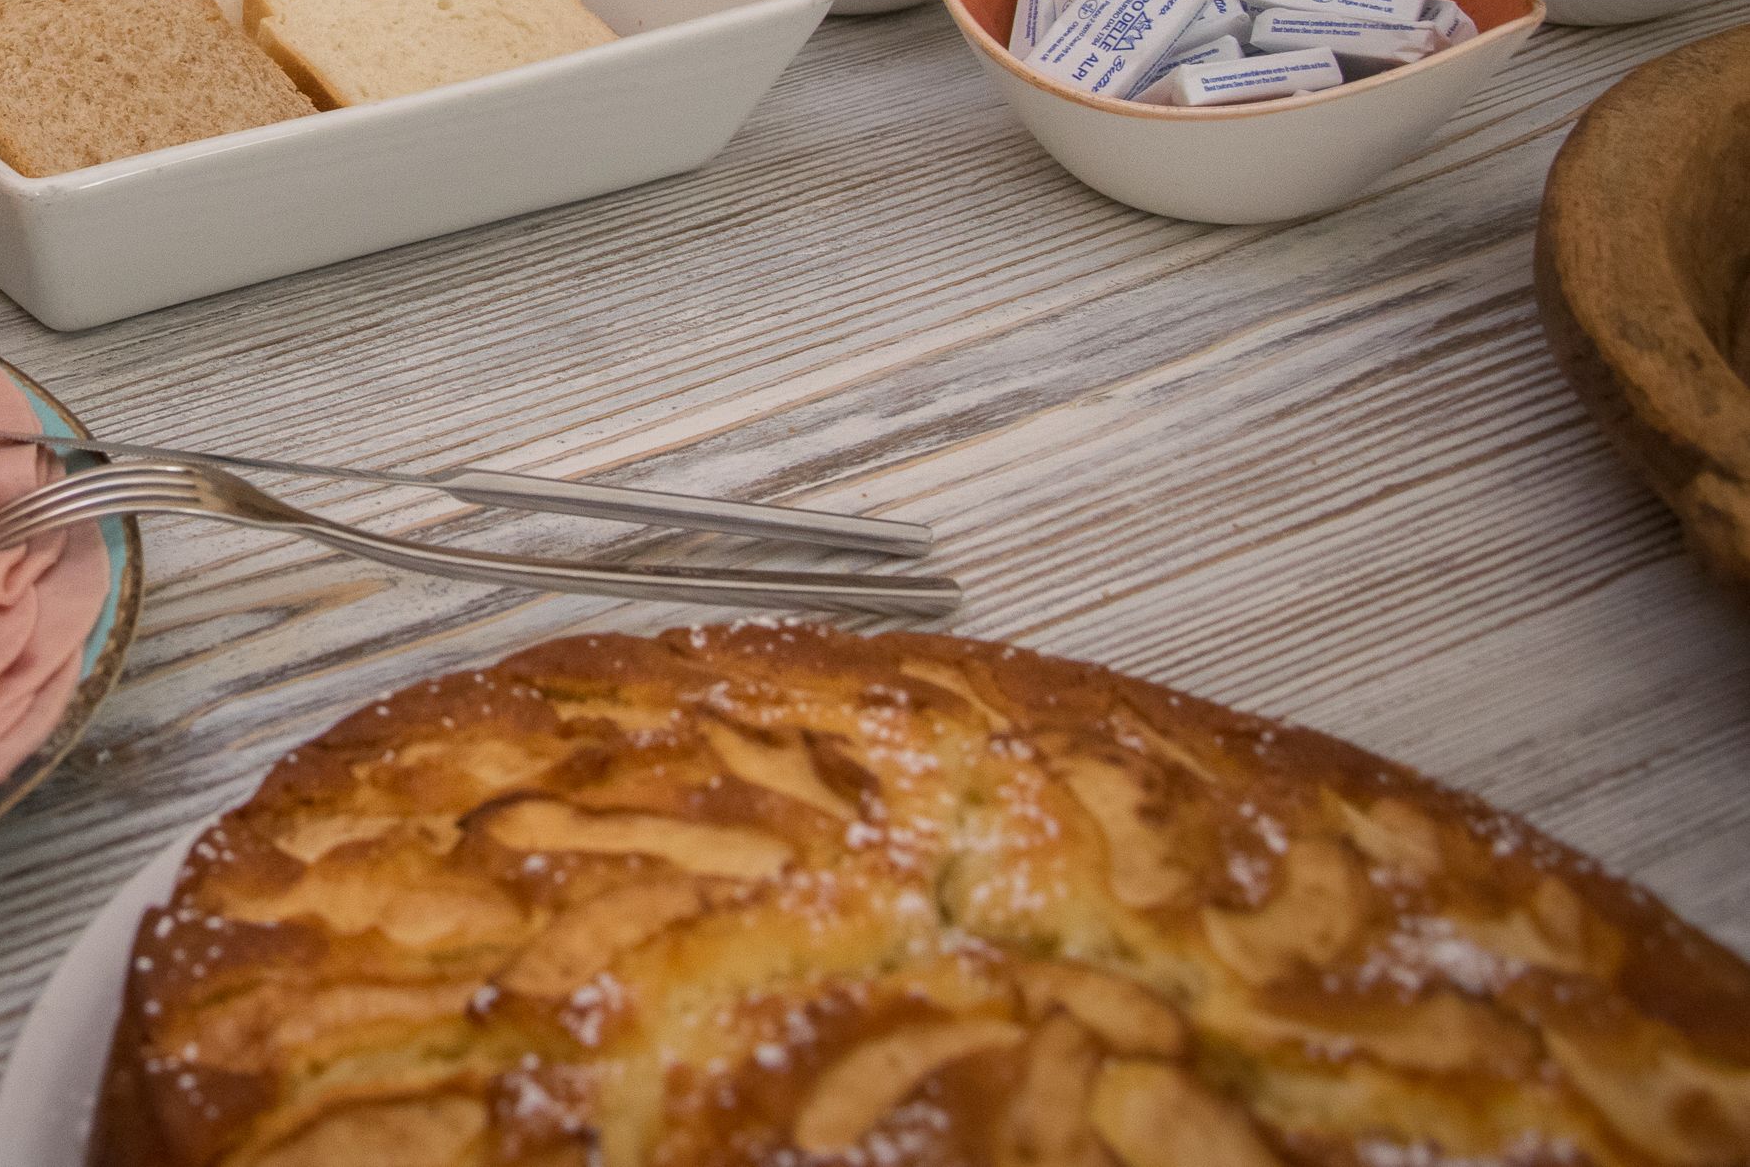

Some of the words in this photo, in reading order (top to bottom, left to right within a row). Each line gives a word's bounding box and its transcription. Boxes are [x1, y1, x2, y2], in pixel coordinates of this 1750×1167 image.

[1099, 12, 1135, 52] DELLE
[1102, 15, 1117, 32] DAL
[1072, 52, 1099, 81] ALPI
[1092, 55, 1125, 92] Butter
